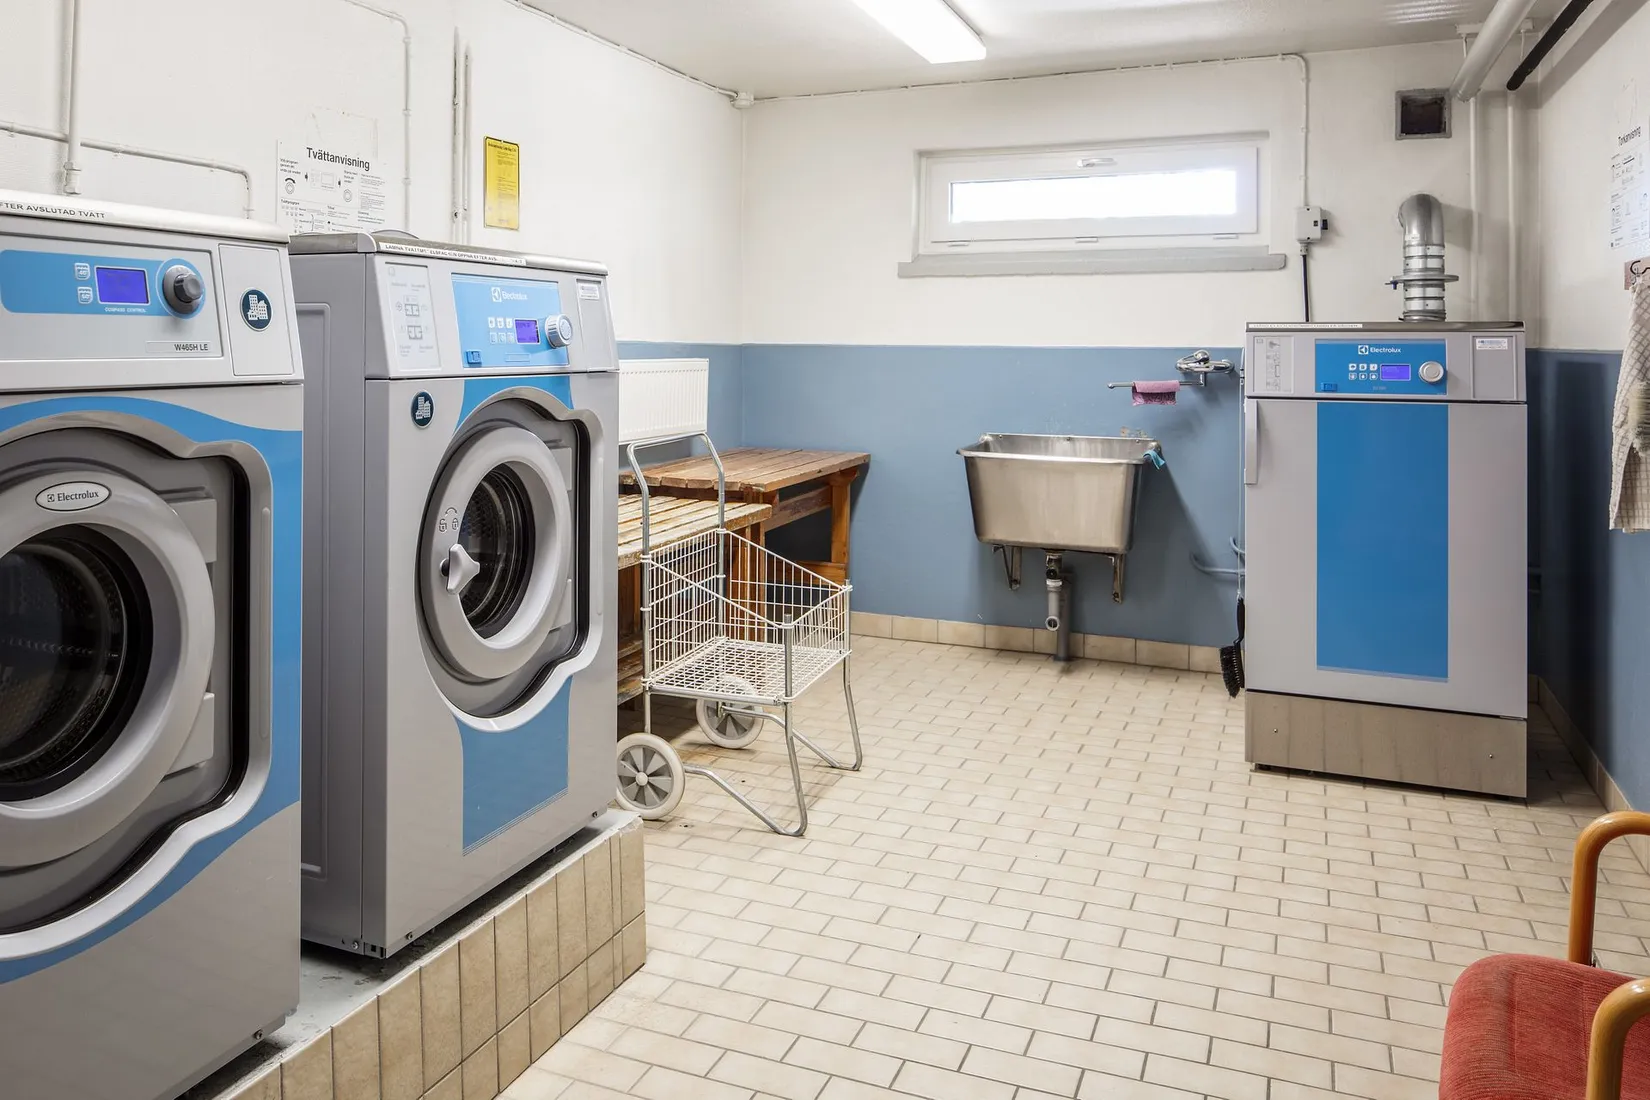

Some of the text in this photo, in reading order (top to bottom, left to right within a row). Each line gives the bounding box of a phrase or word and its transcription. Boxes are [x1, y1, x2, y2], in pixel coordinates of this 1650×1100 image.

[306, 147, 370, 171] Tvättanvisning
[27, 205, 76, 216] AVSLUTAD
[199, 343, 209, 351] LE
[57, 489, 99, 502] Electrolux
